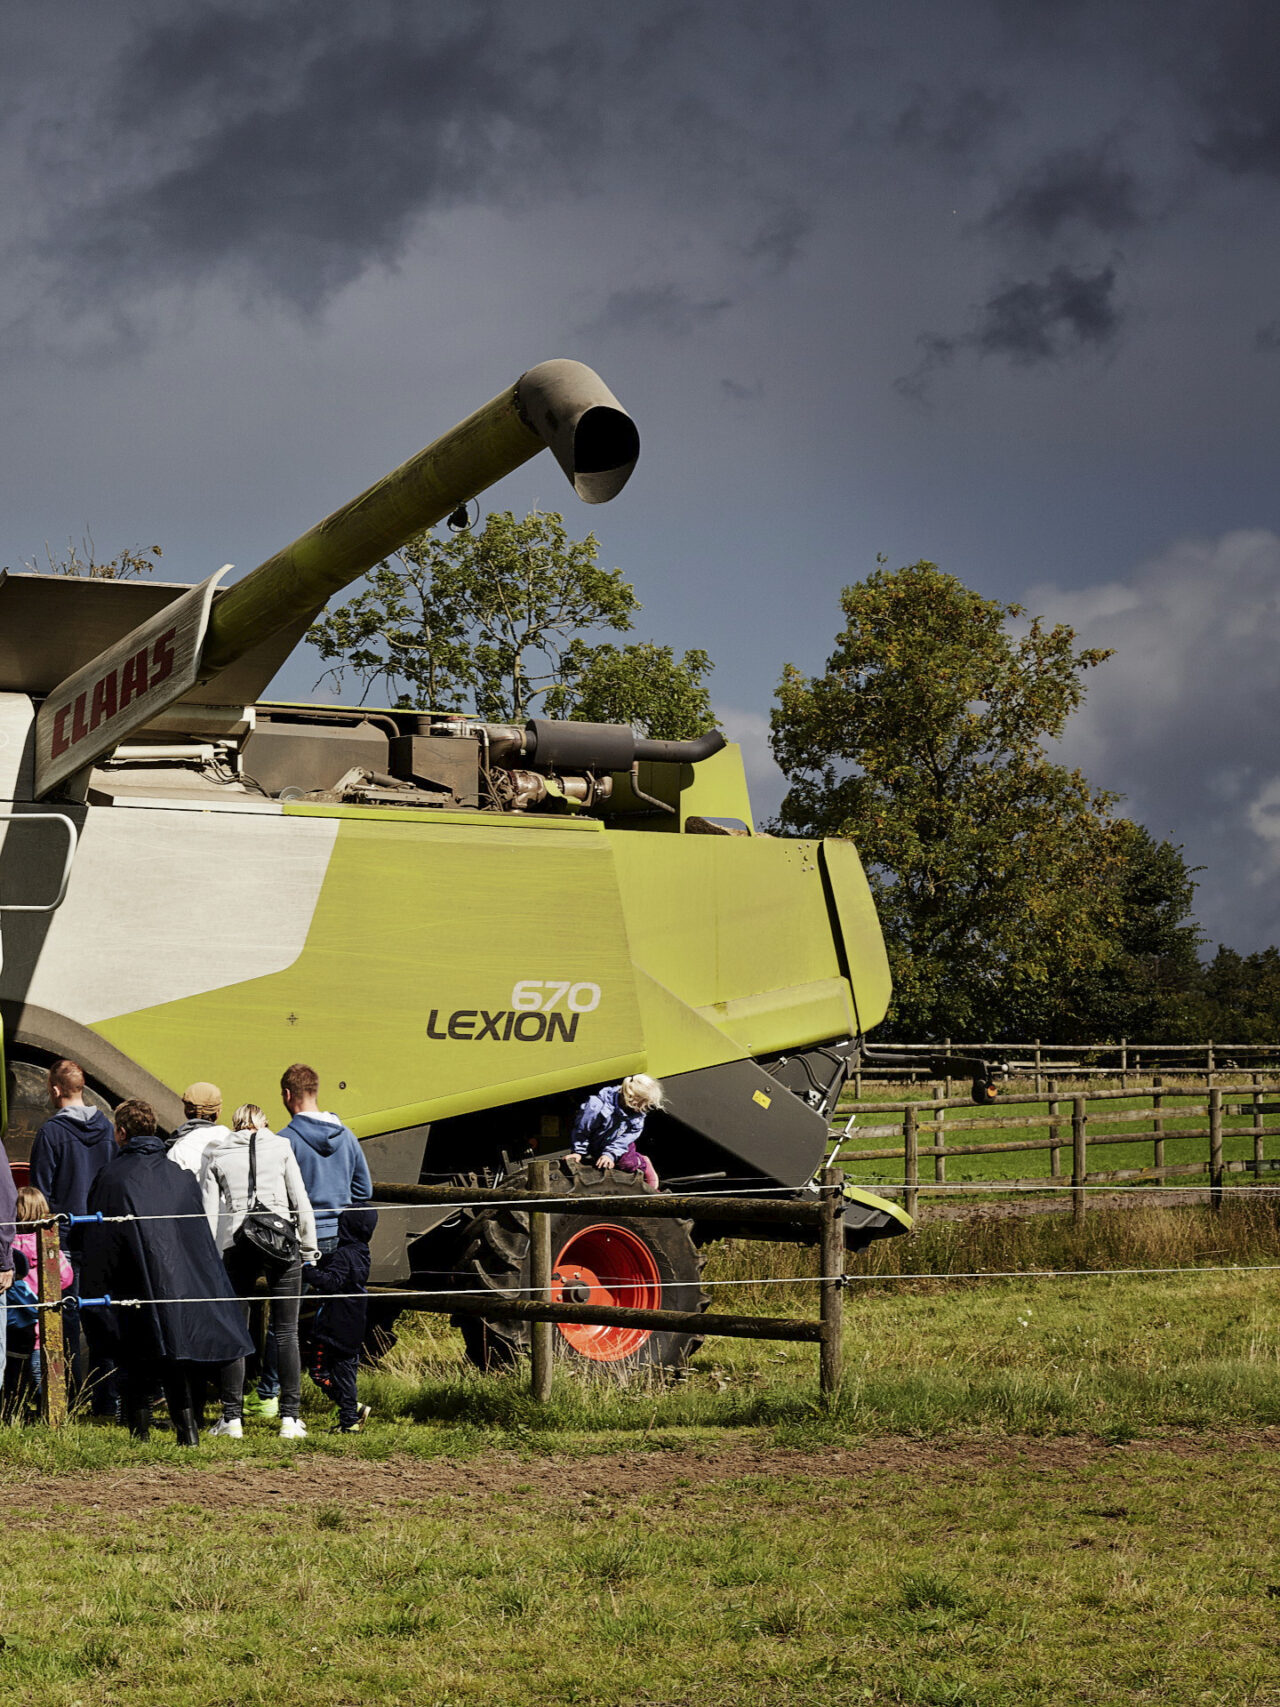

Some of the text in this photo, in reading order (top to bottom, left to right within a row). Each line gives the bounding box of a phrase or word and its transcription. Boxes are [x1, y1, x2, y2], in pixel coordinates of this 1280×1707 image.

[51, 627, 176, 760] CLAAS
[511, 980, 601, 1013] 670
[426, 1009, 579, 1042] LEXION
